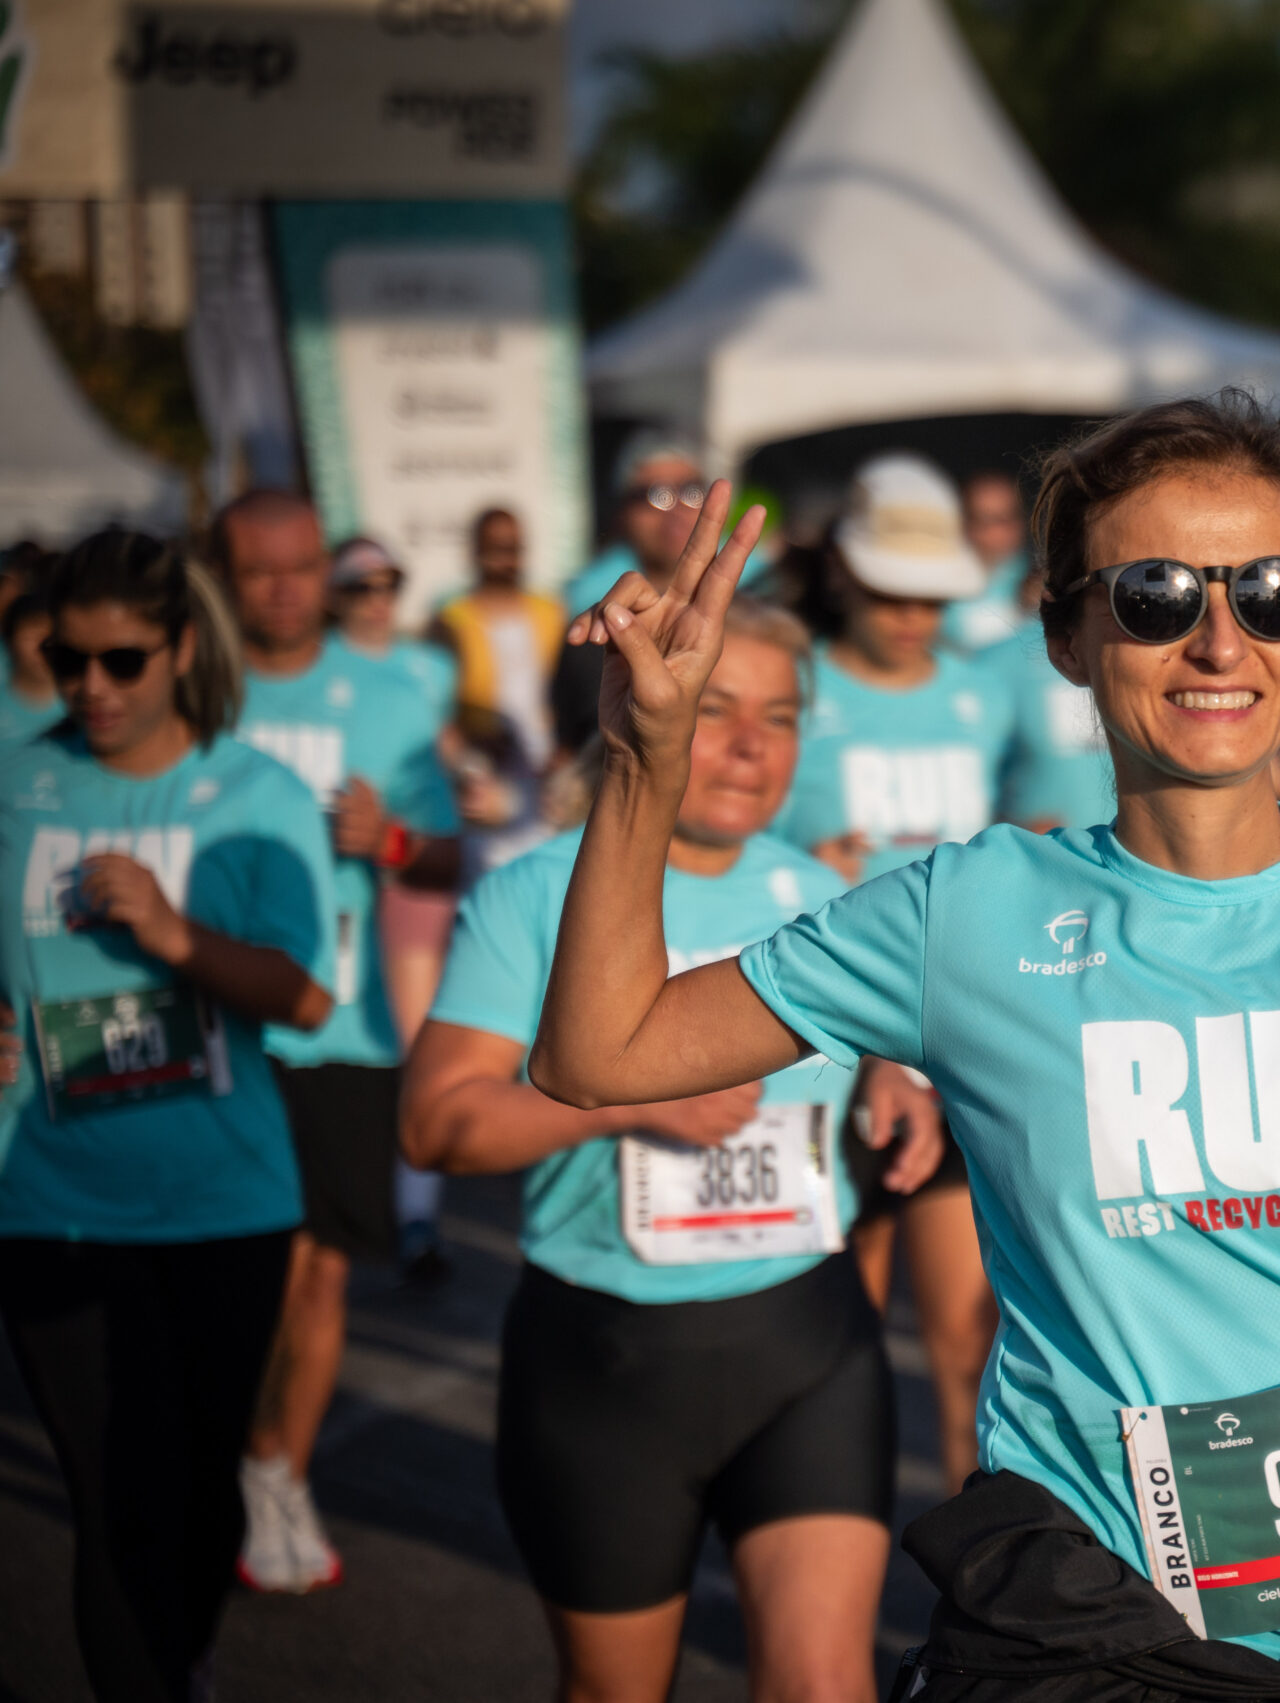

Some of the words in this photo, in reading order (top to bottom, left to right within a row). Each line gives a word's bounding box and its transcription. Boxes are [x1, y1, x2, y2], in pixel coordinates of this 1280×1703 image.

[113, 12, 298, 96] Jeep
[1018, 950, 1107, 976] bradesco
[697, 1144, 779, 1206] 3836
[1101, 1201, 1177, 1239] REST
[1208, 1436, 1254, 1451] bradesco
[1150, 1466, 1193, 1590] BRANCO
